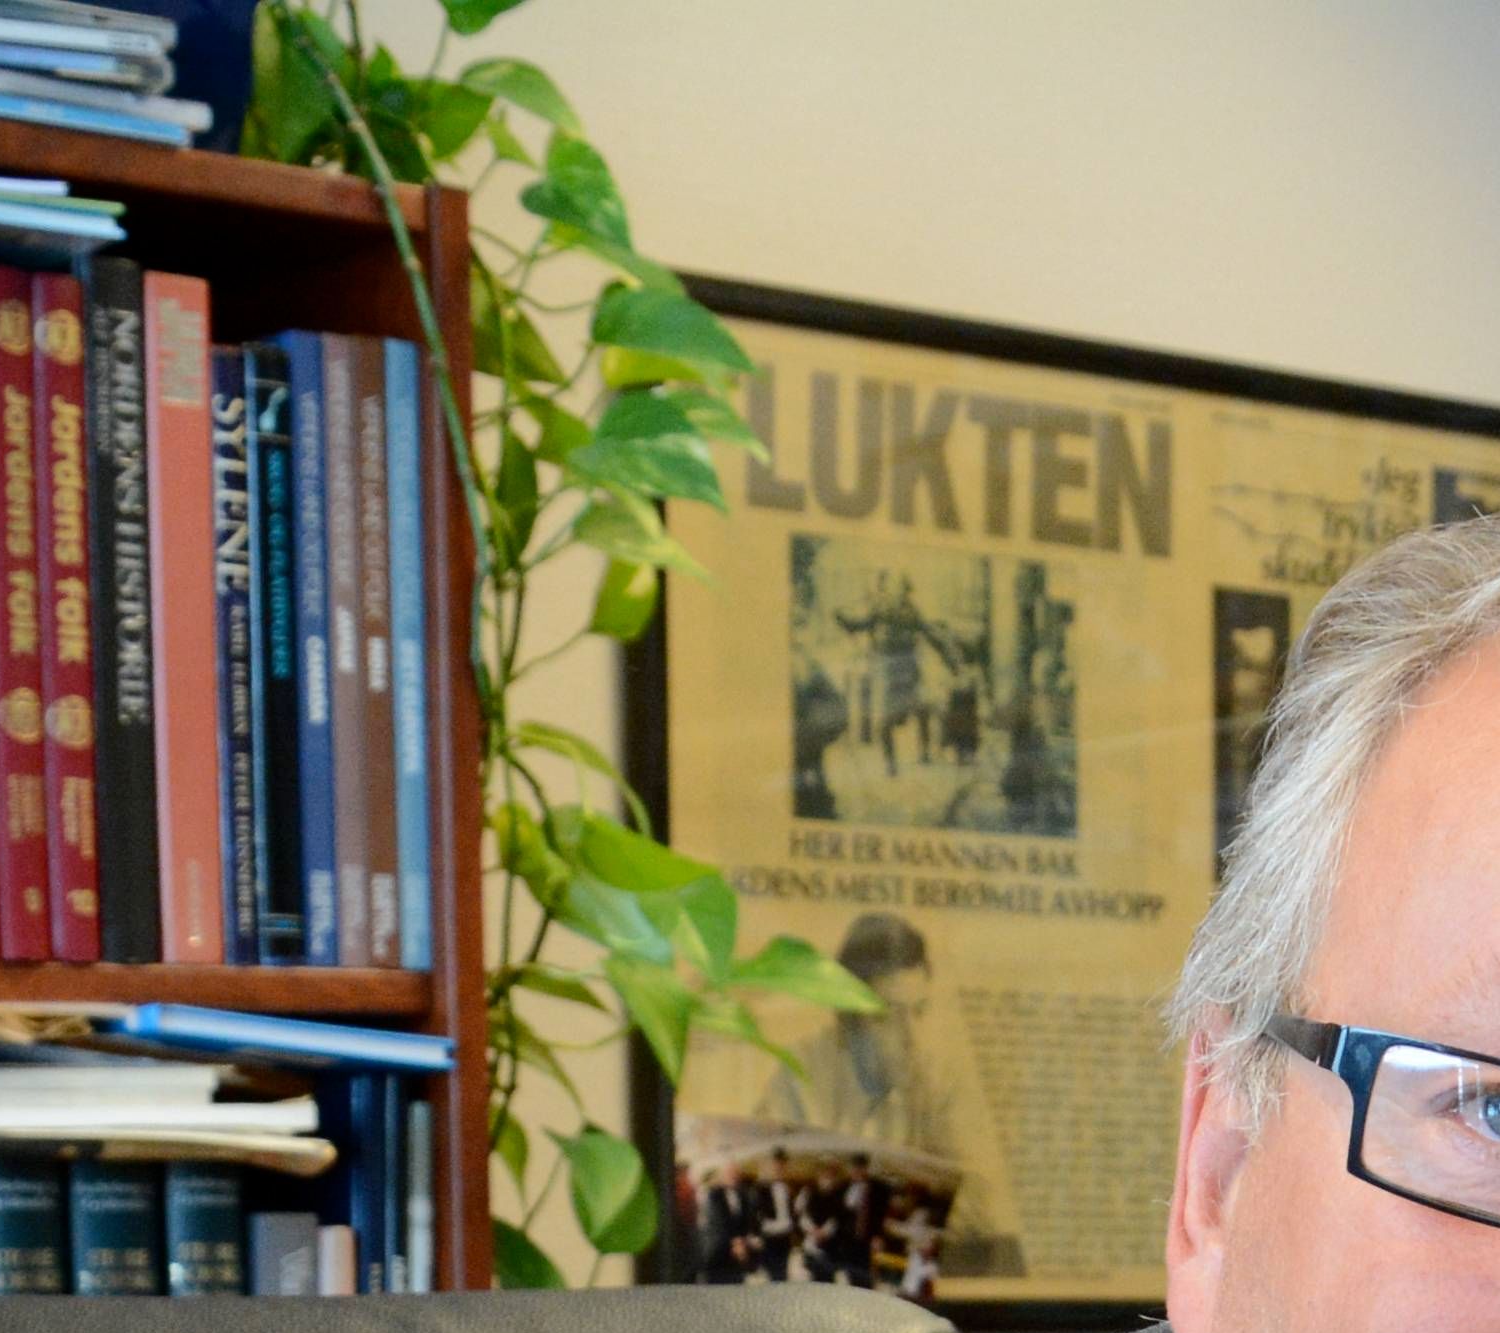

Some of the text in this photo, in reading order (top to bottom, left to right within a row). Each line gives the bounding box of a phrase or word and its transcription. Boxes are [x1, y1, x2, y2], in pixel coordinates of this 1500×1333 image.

[42, 394, 93, 664] Jordens folk
[103, 306, 155, 725] NORDENS HISTORIE
[207, 393, 254, 597] SYLENE
[4, 571, 42, 656] folk
[789, 829, 1079, 876] HER ER MANNEN BAK
[835, 873, 908, 902] MEST
